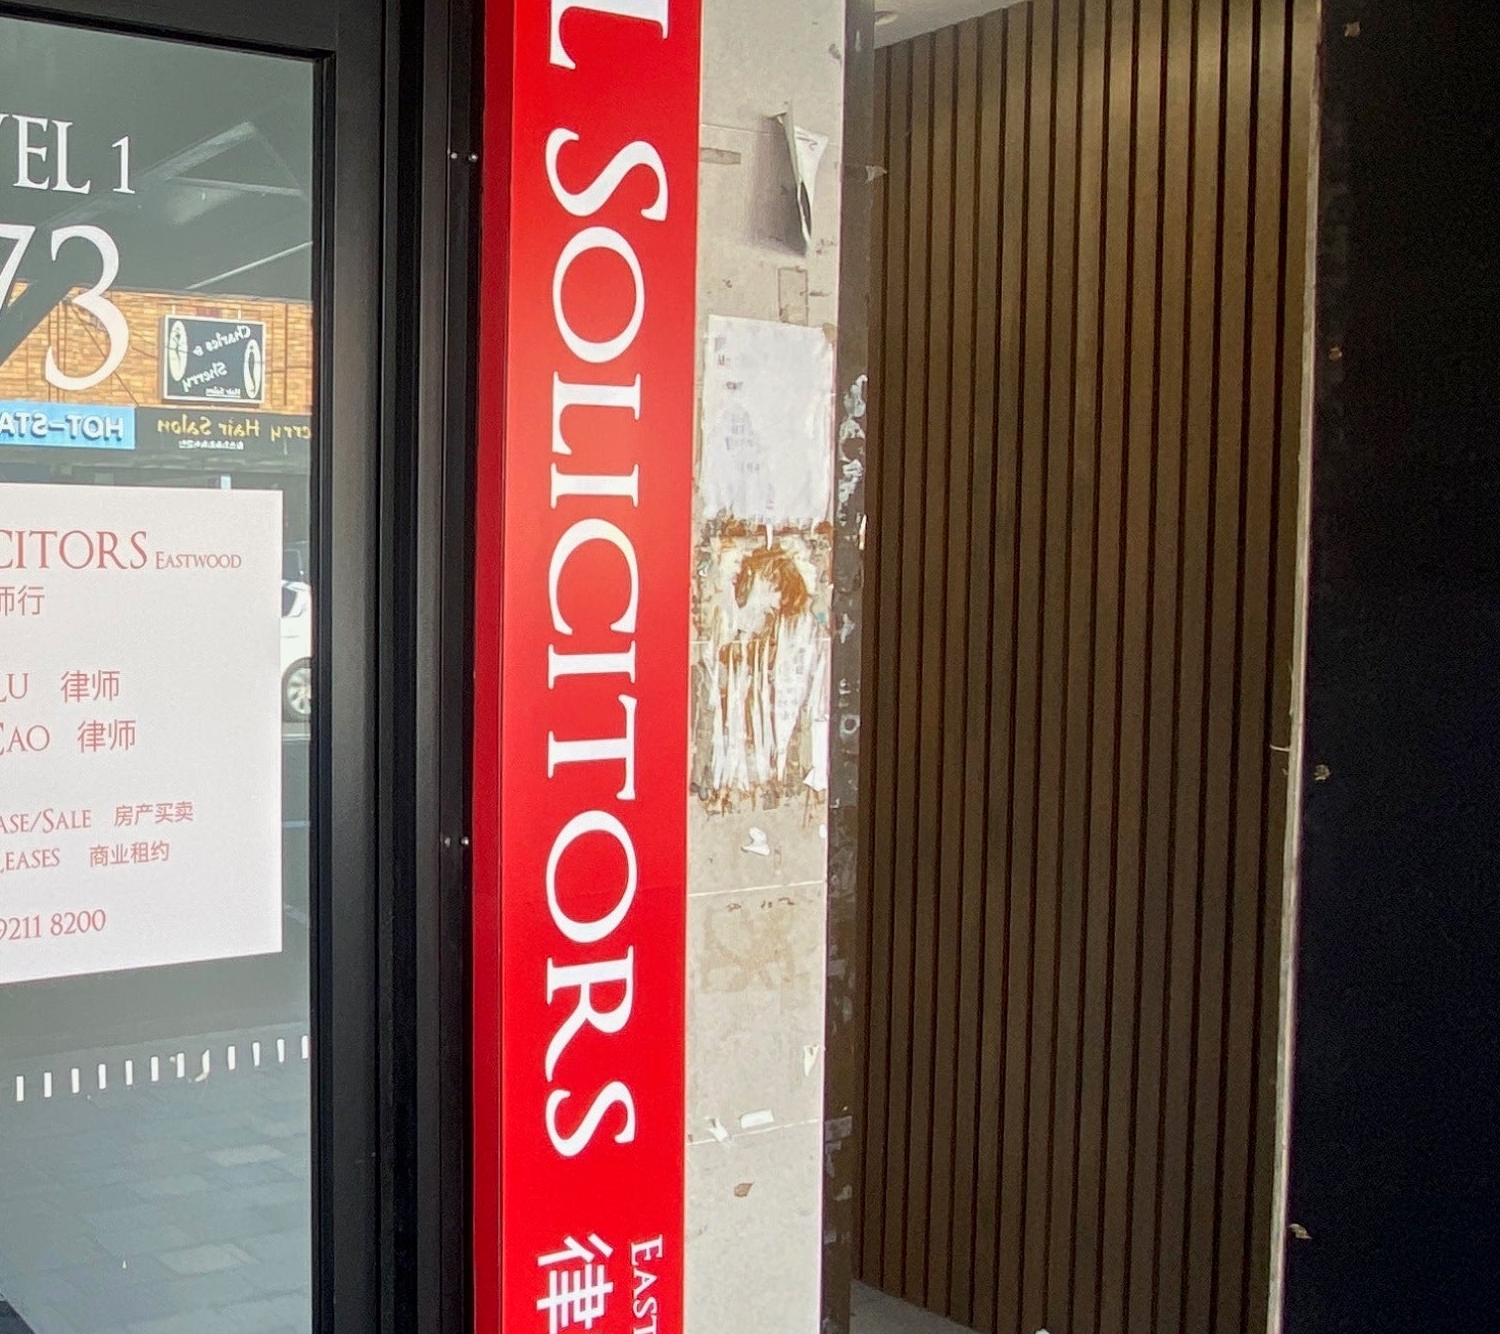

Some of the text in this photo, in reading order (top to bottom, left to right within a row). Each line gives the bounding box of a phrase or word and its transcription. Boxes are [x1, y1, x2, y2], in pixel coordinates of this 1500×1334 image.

[111, 136, 136, 194] 1
[155, 551, 242, 570] EASTWOOD
[542, 128, 670, 1159] SOLICITORS
[60, 669, 121, 704] 律师
[77, 719, 137, 754] 律师
[113, 800, 194, 827] 房产买卖
[88, 840, 170, 868] 商业租约
[50, 908, 108, 937] 8200
